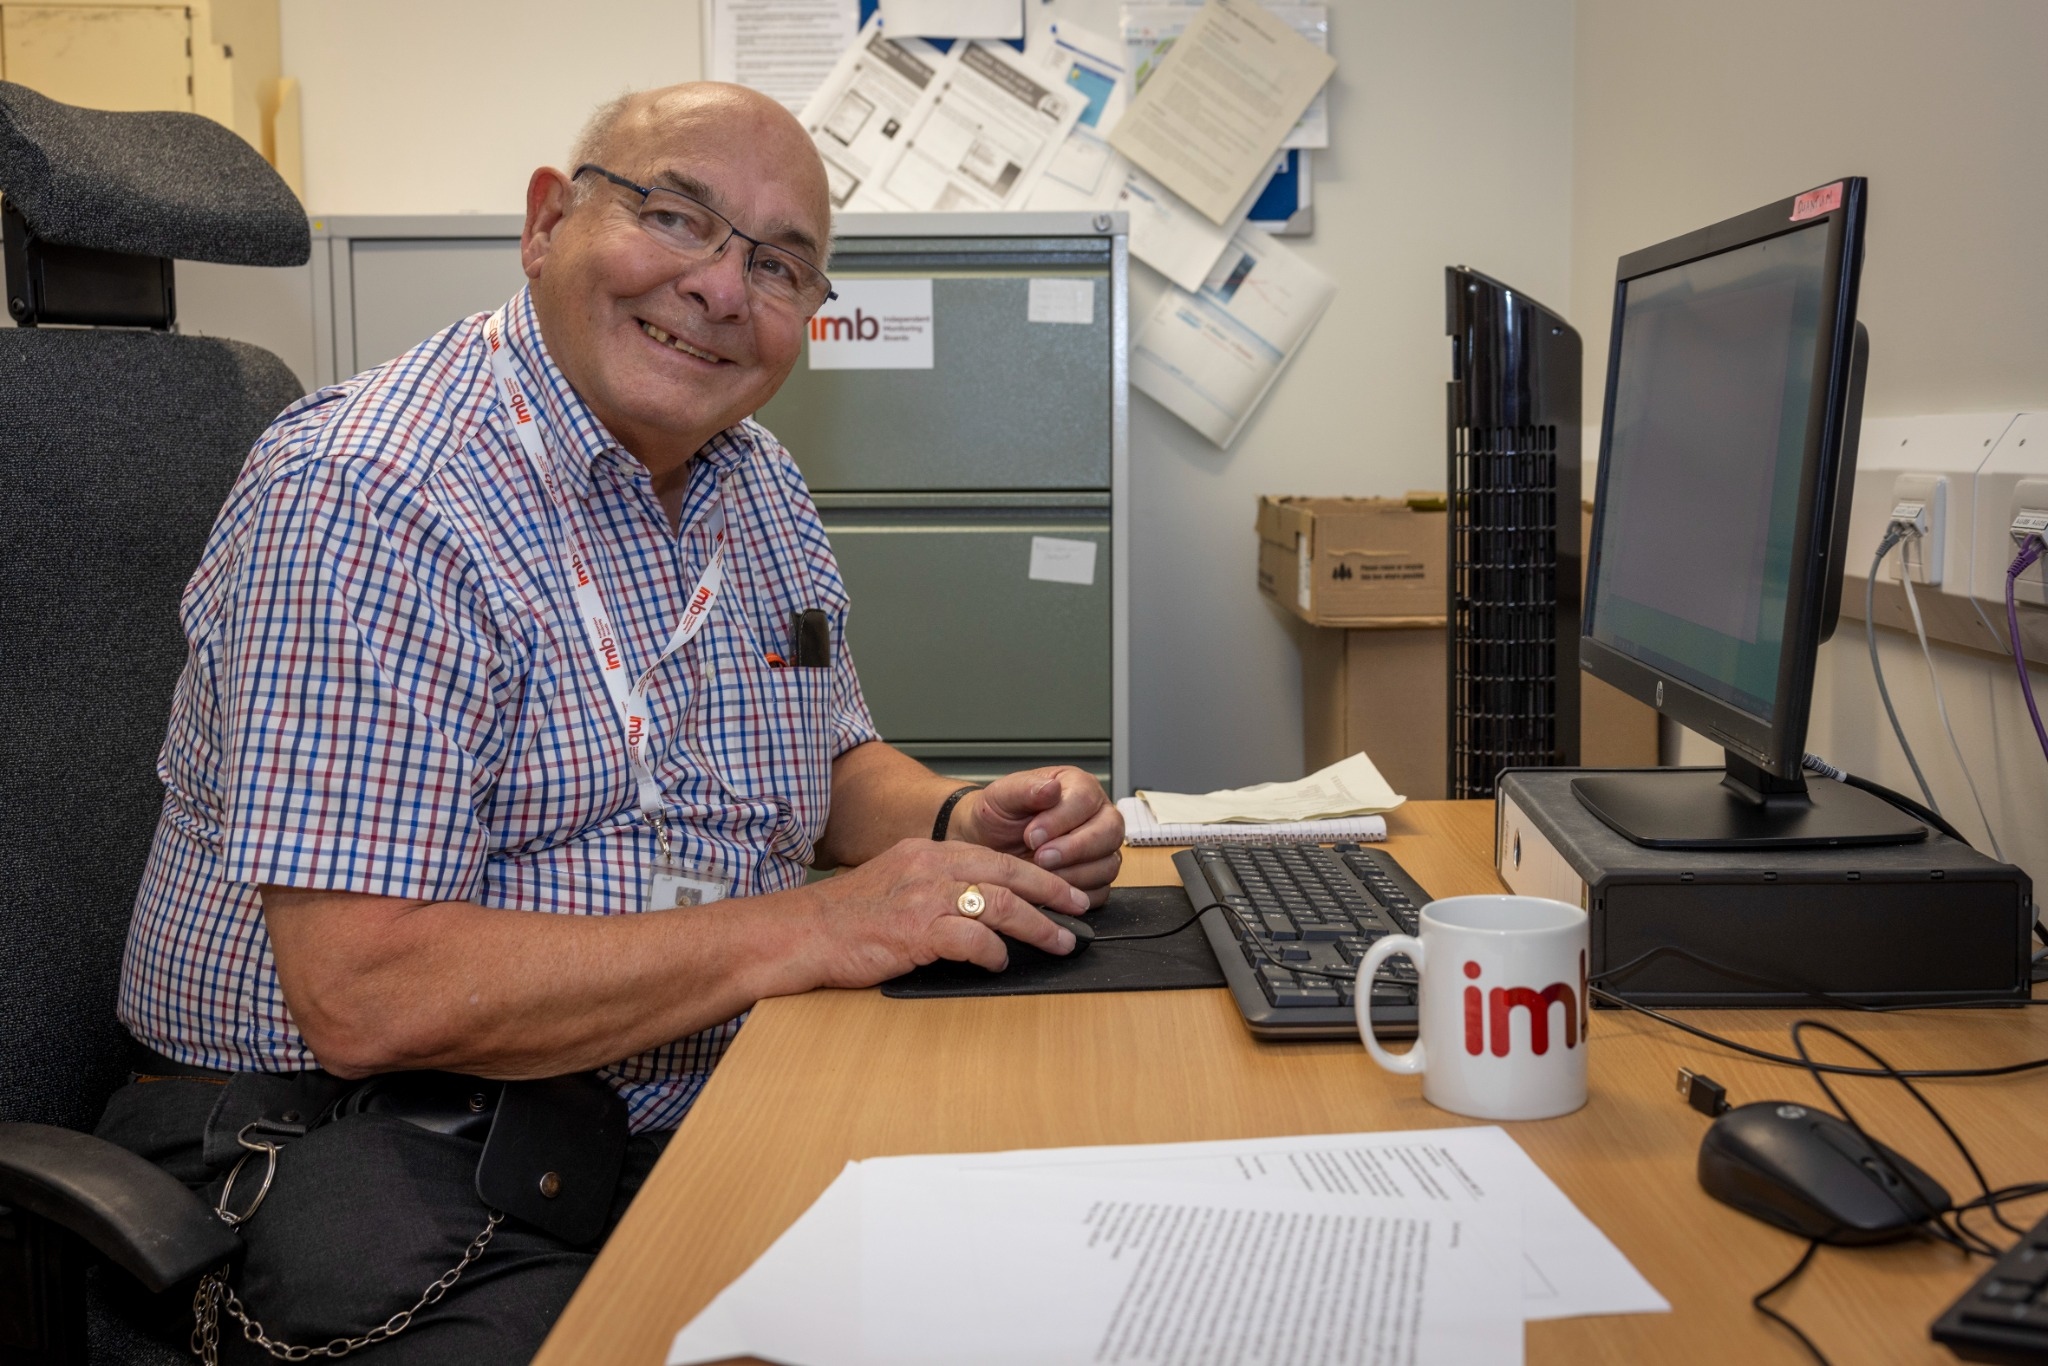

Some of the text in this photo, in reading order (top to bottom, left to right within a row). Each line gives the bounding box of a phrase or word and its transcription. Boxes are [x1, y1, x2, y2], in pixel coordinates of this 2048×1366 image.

[811, 308, 879, 341] imb
[510, 394, 532, 425] imb
[572, 554, 589, 588] imb
[689, 586, 714, 617] imb
[599, 637, 621, 671] imb
[628, 715, 646, 746] imb
[1463, 949, 1589, 1058] im
